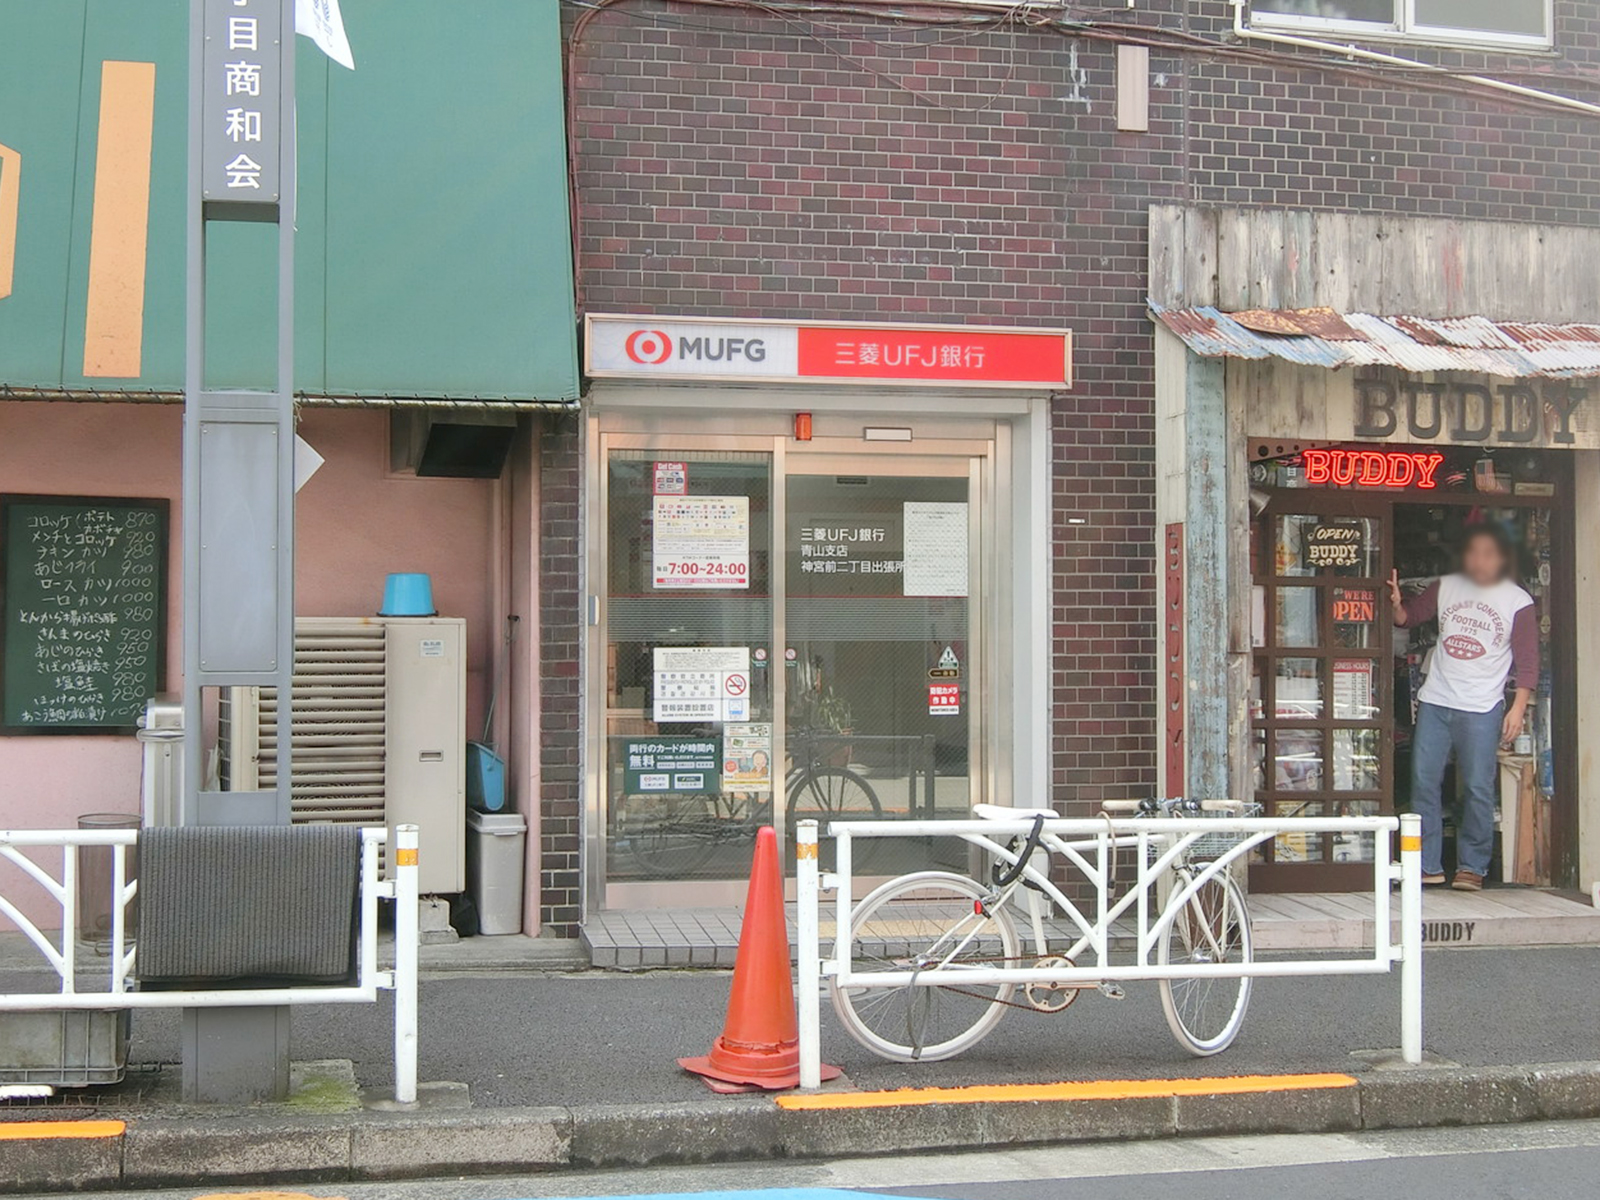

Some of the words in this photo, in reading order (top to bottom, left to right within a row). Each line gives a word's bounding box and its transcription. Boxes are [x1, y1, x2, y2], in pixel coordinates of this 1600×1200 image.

[224, 0, 262, 189] 目商和会
[679, 337, 766, 362] MUFG
[835, 342, 985, 369] 三菱UFJ銀行
[1354, 378, 1588, 444] BUDDY
[1302, 450, 1444, 489] BUDDY
[125, 511, 156, 528] 870
[126, 531, 156, 545] 920
[801, 528, 885, 542] 三菱UFJ銀行
[1316, 528, 1354, 540] OPEN
[801, 544, 848, 557] 青山支店
[1309, 545, 1358, 558] BUDDY
[122, 560, 153, 576] 900
[801, 560, 905, 573] 神宮前二丁目出張所
[124, 606, 153, 621] 980
[1451, 614, 1491, 632] FOOTBALL
[1476, 602, 1505, 648] CONFERENCE
[121, 627, 152, 641] 920
[117, 641, 149, 655] 950
[115, 656, 146, 671] 950
[112, 672, 146, 686] 980
[112, 686, 145, 702] 980
[629, 755, 655, 768] 無料
